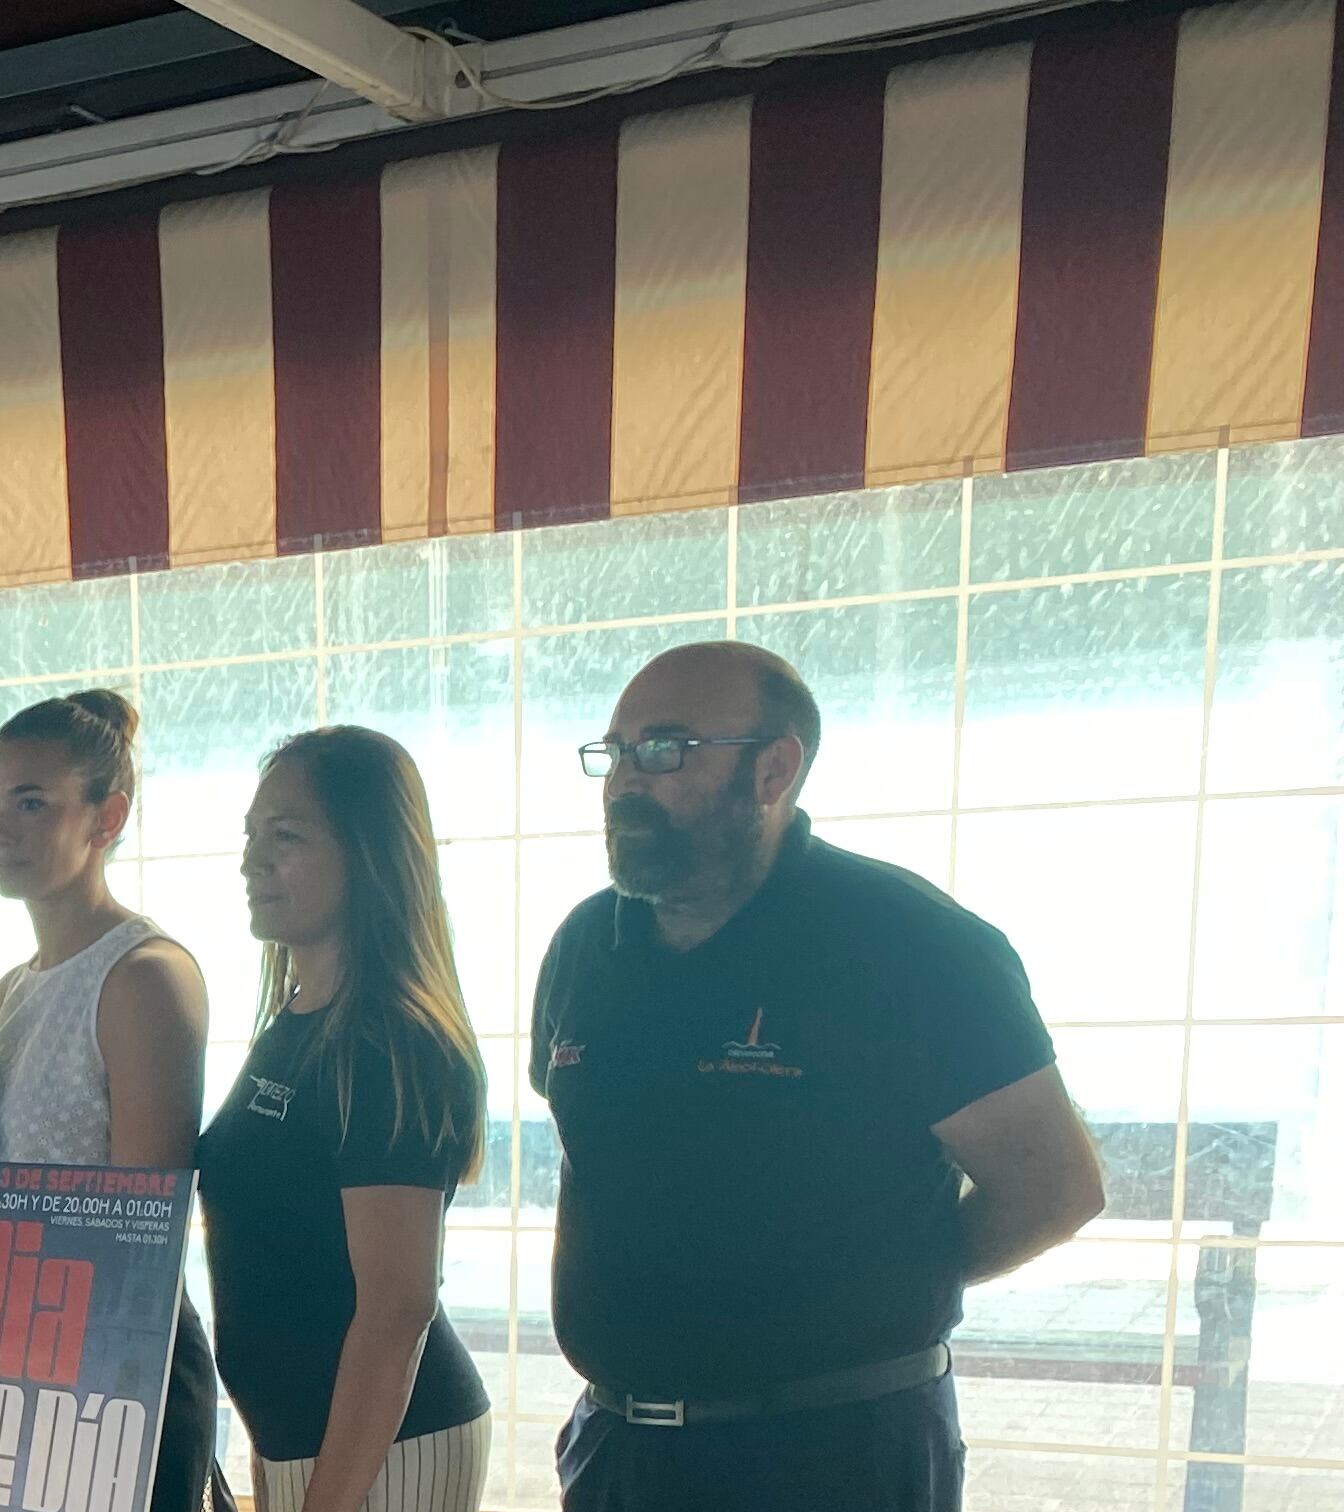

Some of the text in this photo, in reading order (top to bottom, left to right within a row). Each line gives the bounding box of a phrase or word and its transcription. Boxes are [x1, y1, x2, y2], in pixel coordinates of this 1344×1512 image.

[46, 1168, 177, 1195] SEPTIEMBRE
[29, 1194, 39, 1210] Y
[42, 1195, 61, 1211] DE
[112, 1198, 123, 1215] A
